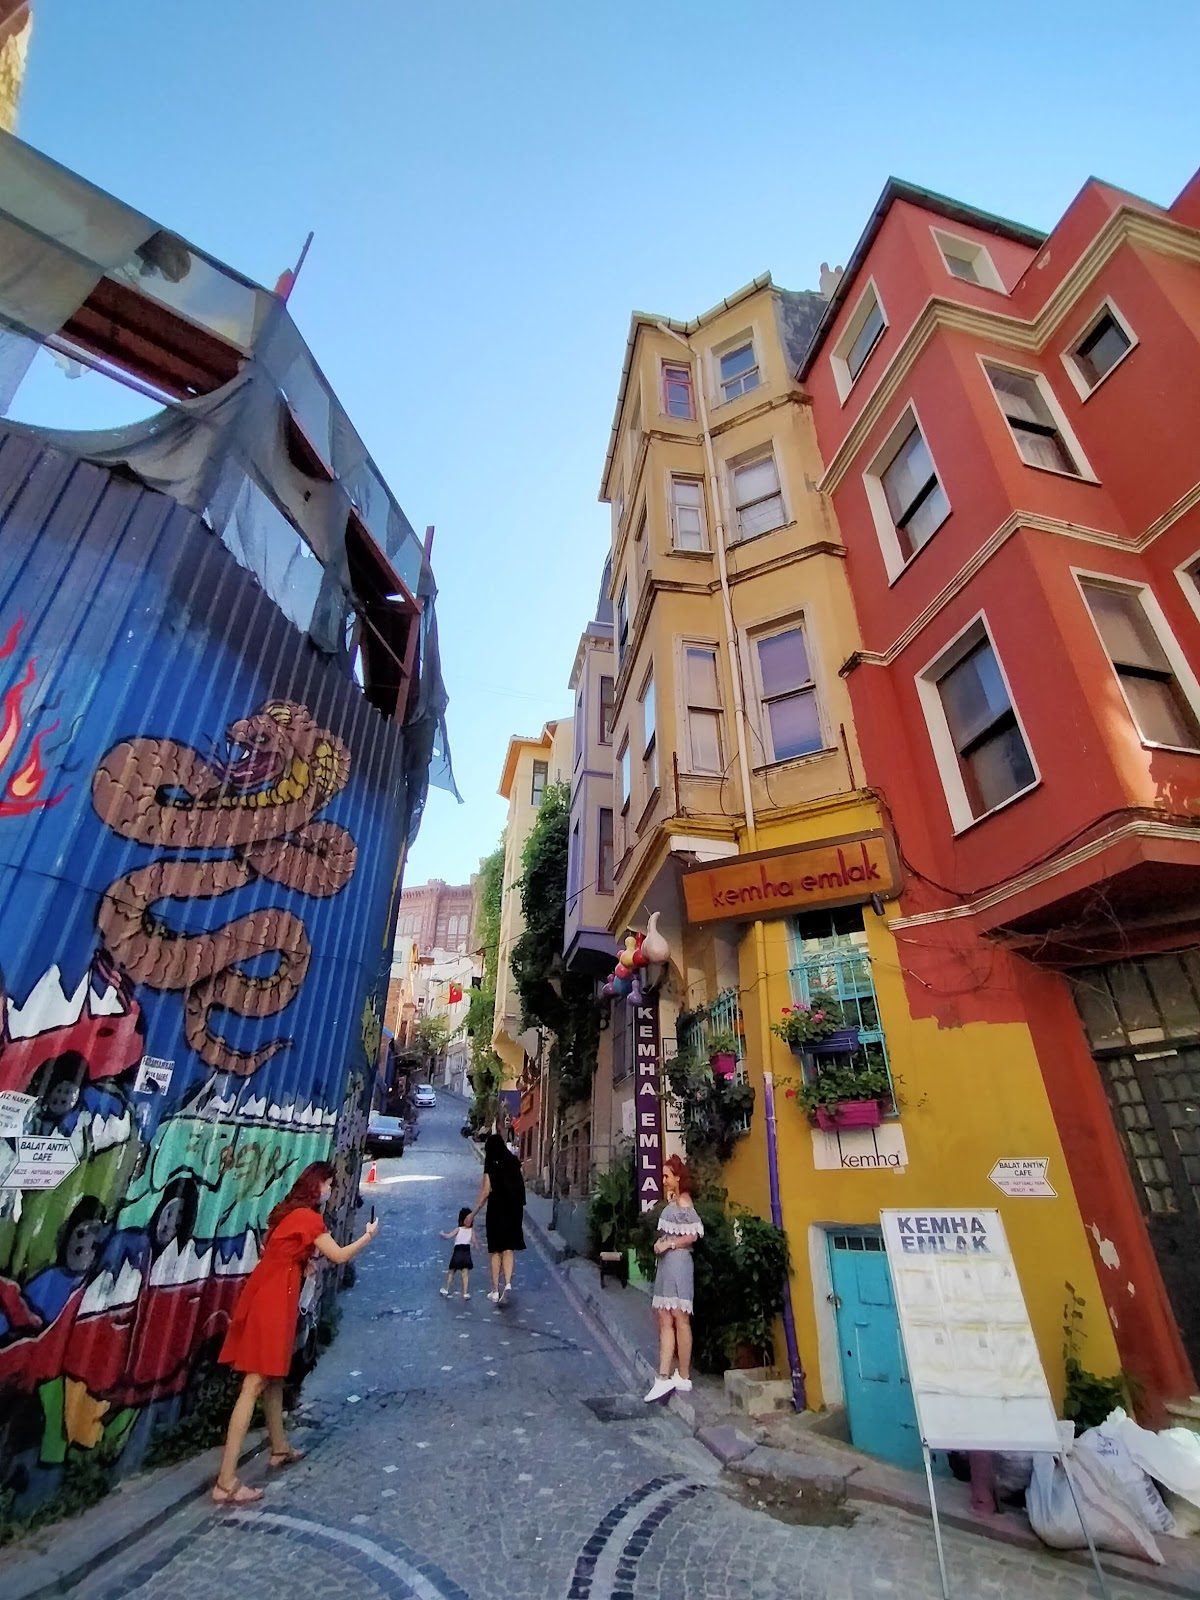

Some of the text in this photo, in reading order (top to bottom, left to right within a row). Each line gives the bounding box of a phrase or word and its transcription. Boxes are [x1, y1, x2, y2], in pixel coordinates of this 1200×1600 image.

[708, 842, 881, 907] kemha emlak
[637, 1007, 659, 1213] KEMHA EMLAK
[20, 1141, 46, 1150] BALAT
[836, 1128, 901, 1168] kemha
[32, 1152, 53, 1161] CAFE
[897, 1217, 986, 1235] KEMHA
[901, 1235, 991, 1255] EMLAK
